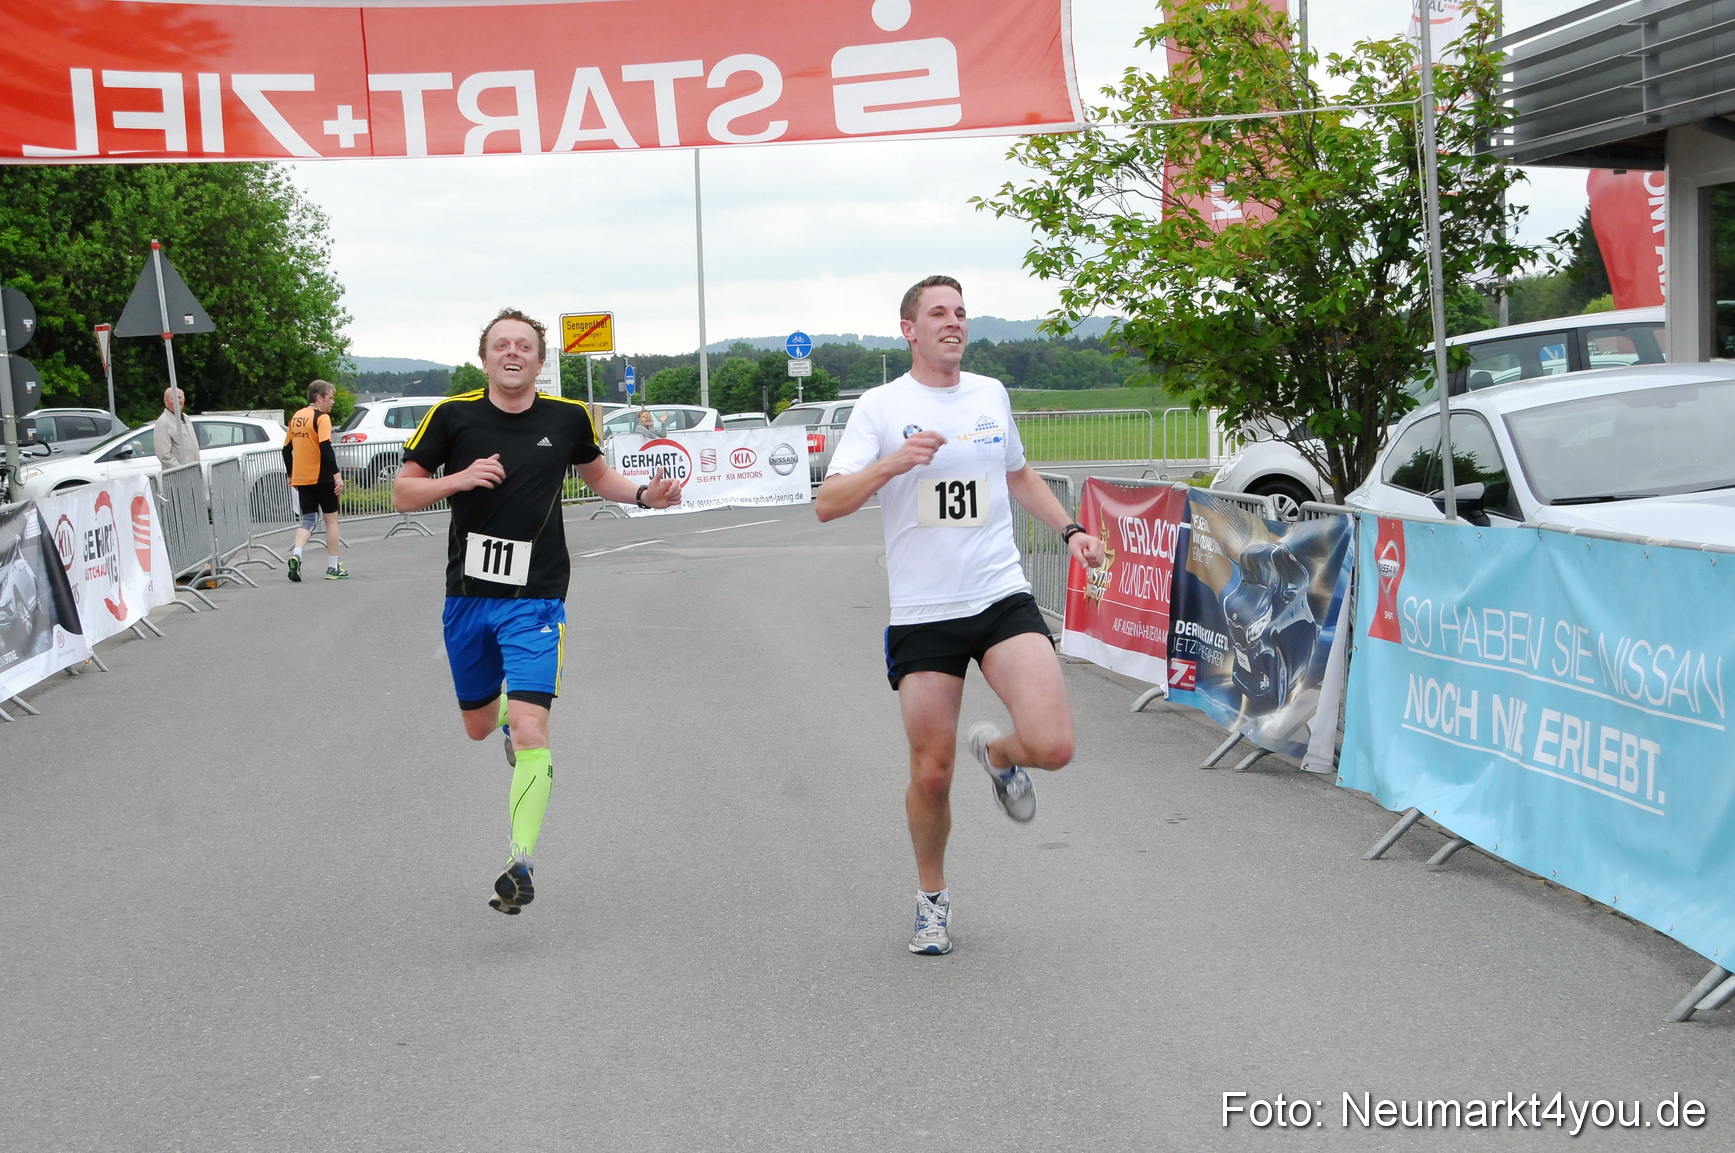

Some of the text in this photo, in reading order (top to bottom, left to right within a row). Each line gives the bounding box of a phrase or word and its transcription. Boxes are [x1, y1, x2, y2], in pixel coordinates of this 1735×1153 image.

[566, 319, 608, 332] Sengenthal
[292, 416, 310, 428] TSV
[622, 452, 678, 469] GERHART
[733, 452, 752, 464] KIA
[771, 455, 797, 464] NISSAN
[622, 466, 686, 481] Autohaus JNIG
[696, 474, 723, 483] SEAT
[726, 470, 763, 481] KIA MOTORS
[935, 480, 978, 520] 131
[58, 529, 73, 558] KIA
[482, 538, 515, 577] 111
[1174, 619, 1198, 637] DER
[1171, 636, 1198, 654] JETZ
[1403, 595, 1726, 719] SO HABEN SIE NISSAN
[1169, 660, 1190, 685] 7
[1403, 672, 1478, 741] NOCH
[1532, 707, 1666, 805] ERLEBT.
